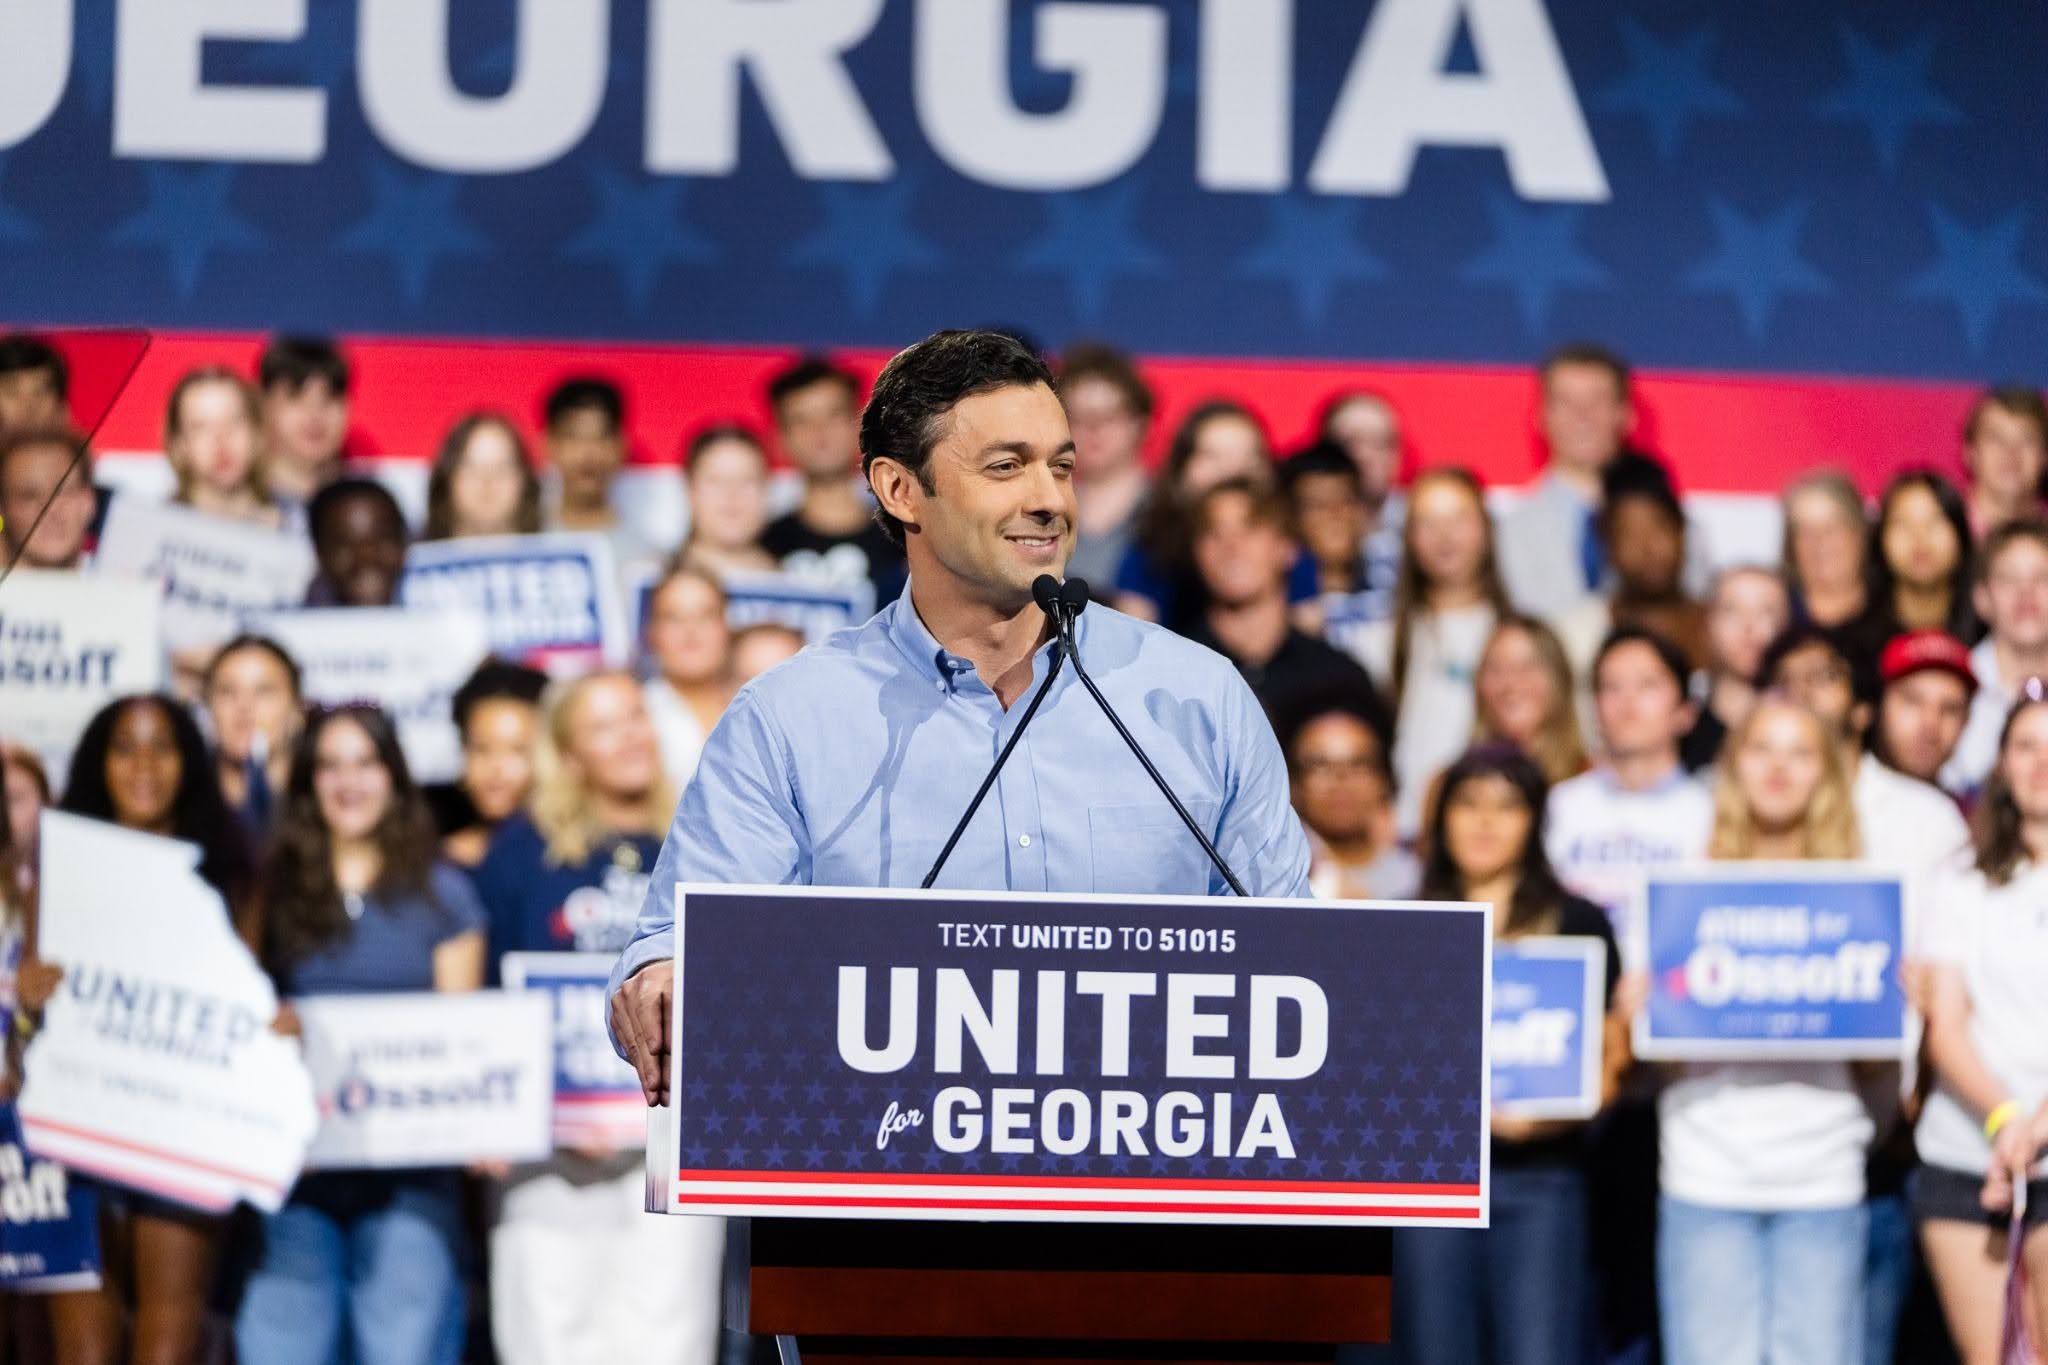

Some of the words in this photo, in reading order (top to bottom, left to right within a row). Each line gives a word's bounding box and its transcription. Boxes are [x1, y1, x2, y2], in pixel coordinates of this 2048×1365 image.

[0, 0, 1612, 203] EORGIA
[938, 923, 1007, 947] TEXT
[1012, 925, 1113, 950] UNITED
[1119, 927, 1153, 951] TO
[1159, 928, 1236, 952] 51015
[1686, 941, 1890, 1007] Ossoff
[69, 963, 259, 1043] UNITED
[837, 965, 1329, 1081] UNITED
[335, 1063, 523, 1118] Ossoff
[876, 1102, 924, 1151] for
[932, 1086, 1297, 1159] GEORGIA
